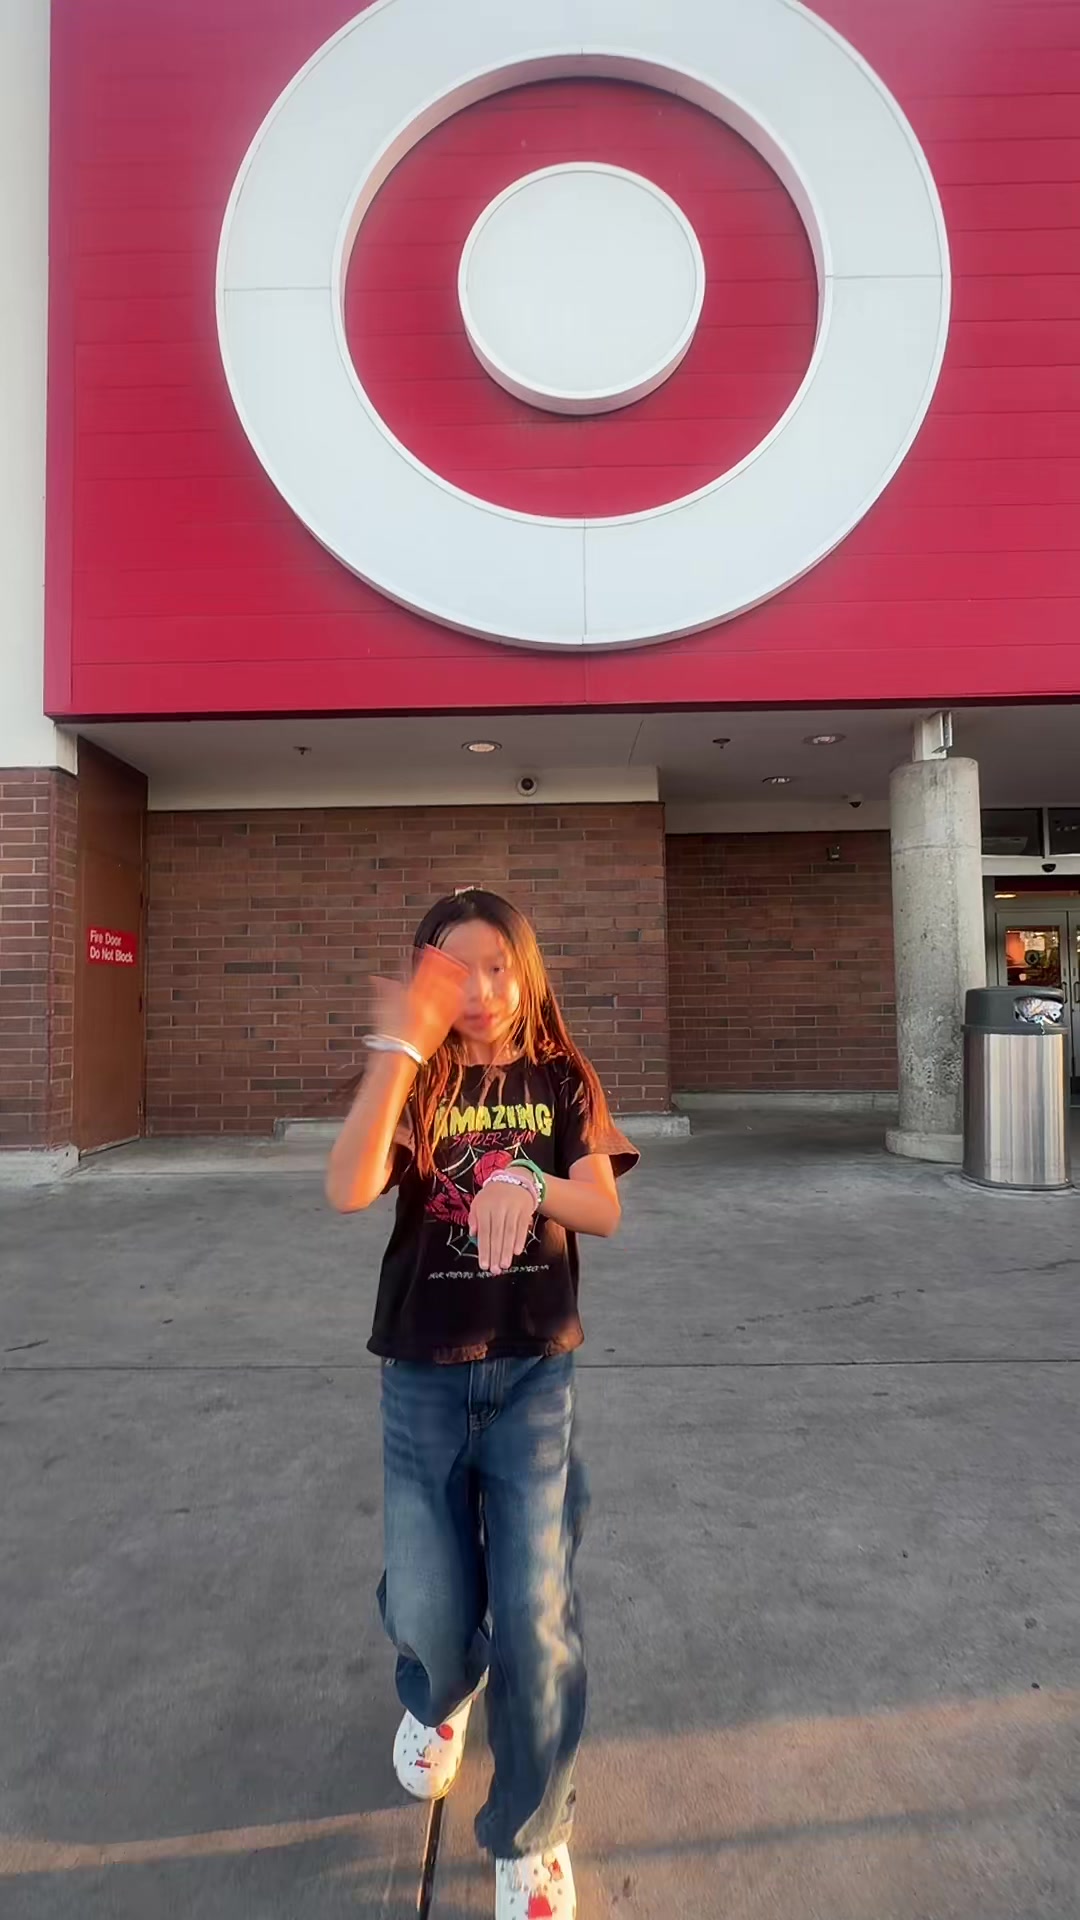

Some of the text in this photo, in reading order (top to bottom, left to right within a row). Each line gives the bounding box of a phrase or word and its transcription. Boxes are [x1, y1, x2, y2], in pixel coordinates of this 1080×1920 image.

[90, 929, 122, 946] Fire Door
[90, 945, 133, 963] Do Not Block
